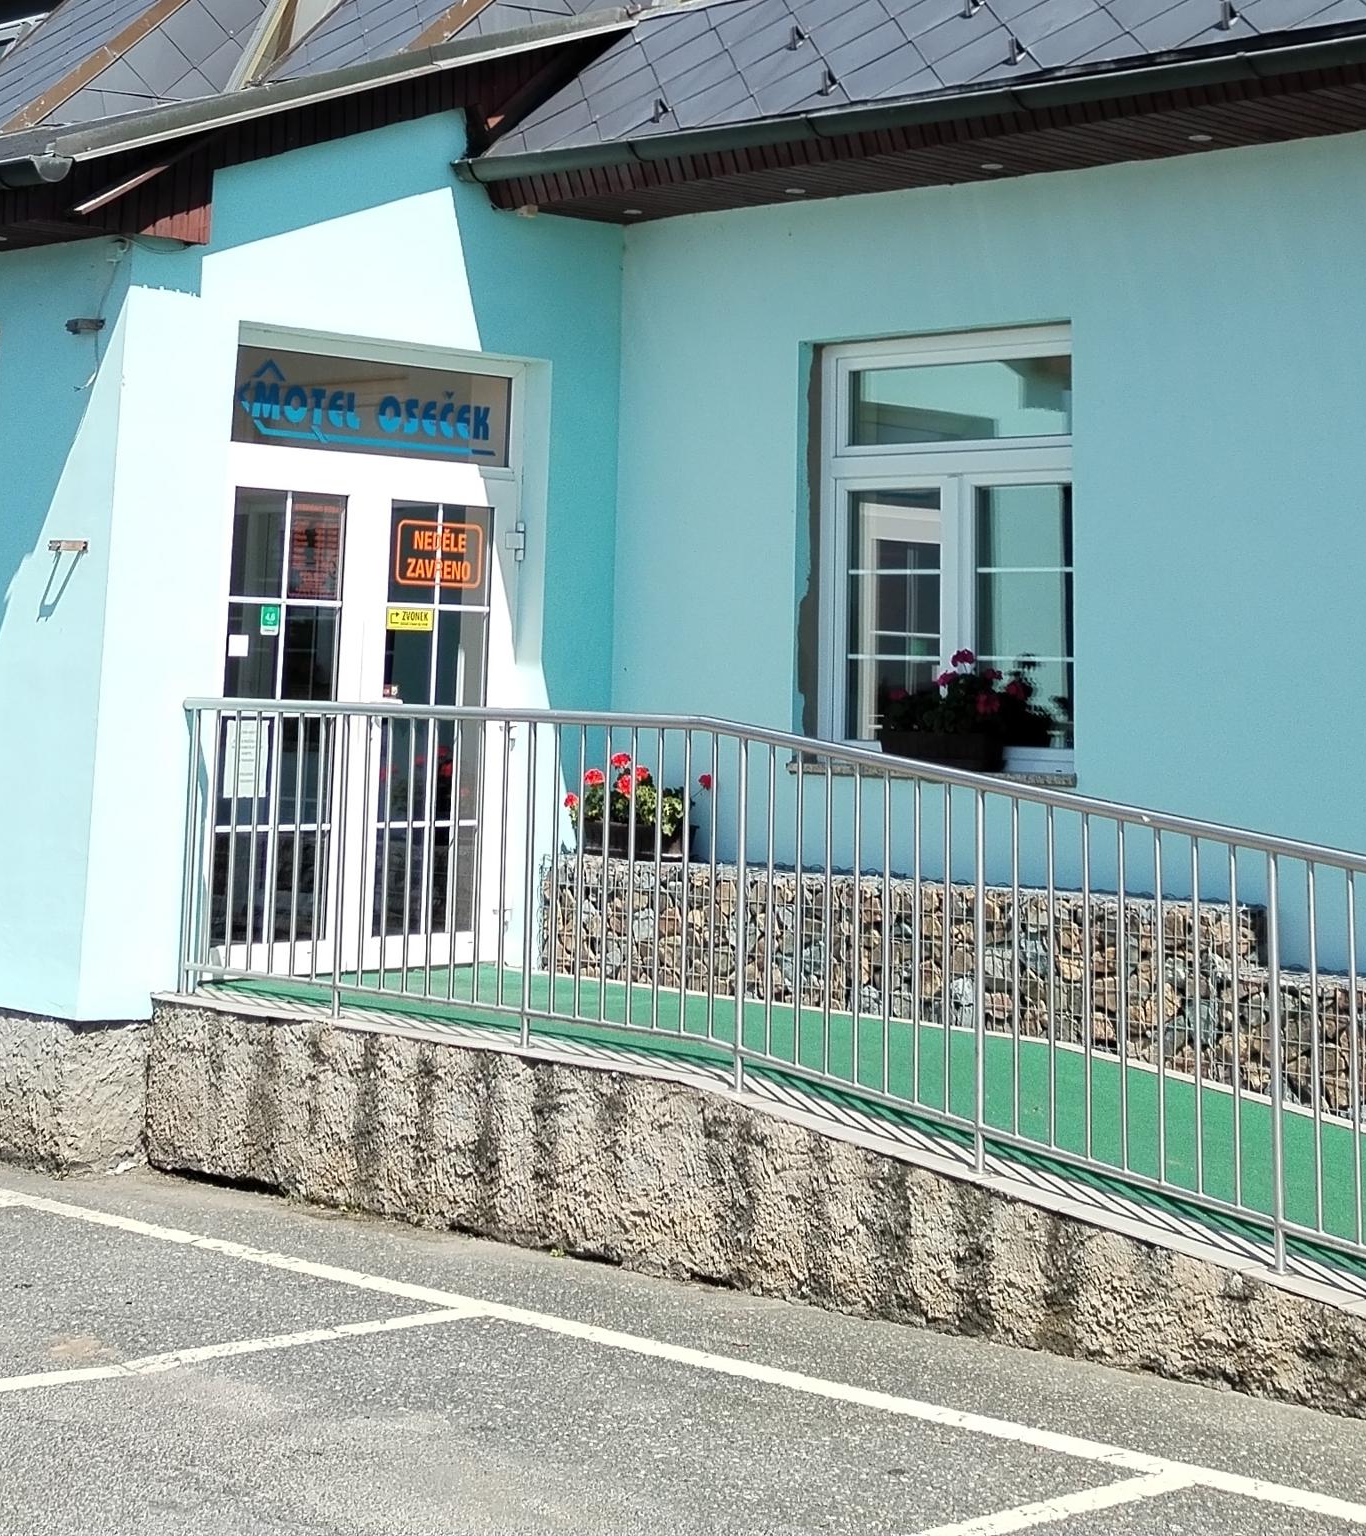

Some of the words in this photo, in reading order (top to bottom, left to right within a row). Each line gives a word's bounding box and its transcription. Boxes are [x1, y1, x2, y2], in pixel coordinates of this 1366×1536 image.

[251, 379, 361, 431] MOTEL
[378, 390, 491, 441] OSEČEK
[413, 528, 468, 553] NEDĚLE
[401, 611, 429, 621] ZVONEK
